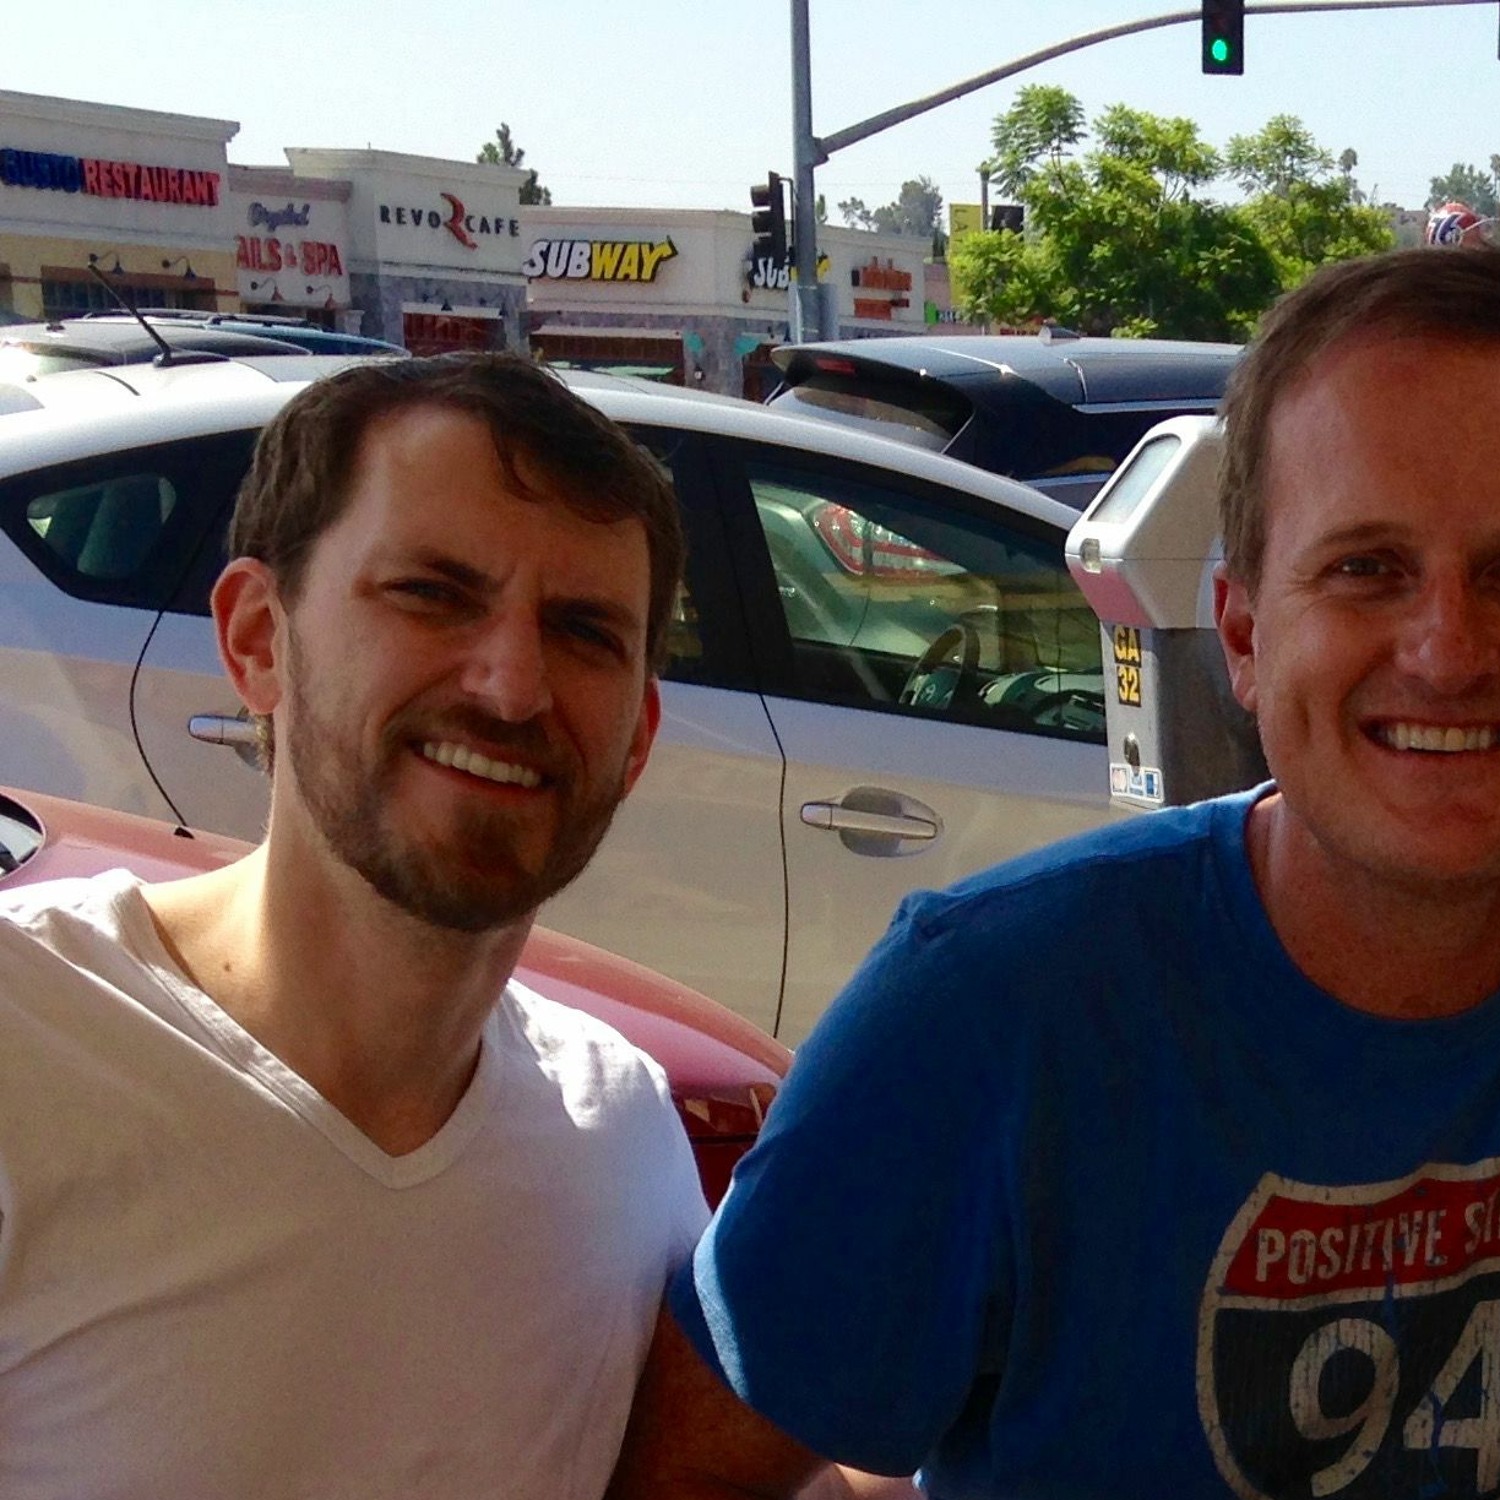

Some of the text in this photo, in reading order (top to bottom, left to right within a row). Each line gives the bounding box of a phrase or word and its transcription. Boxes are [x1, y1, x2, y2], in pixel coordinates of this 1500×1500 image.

[81, 158, 220, 206] RESTAURANT
[379, 205, 520, 237] REVO CAFE
[236, 235, 282, 272] AILS
[300, 241, 342, 276] SPA
[522, 236, 679, 283] SUBWAY
[1118, 666, 1140, 704] 32
[1254, 1208, 1447, 1286] POSITIVE
